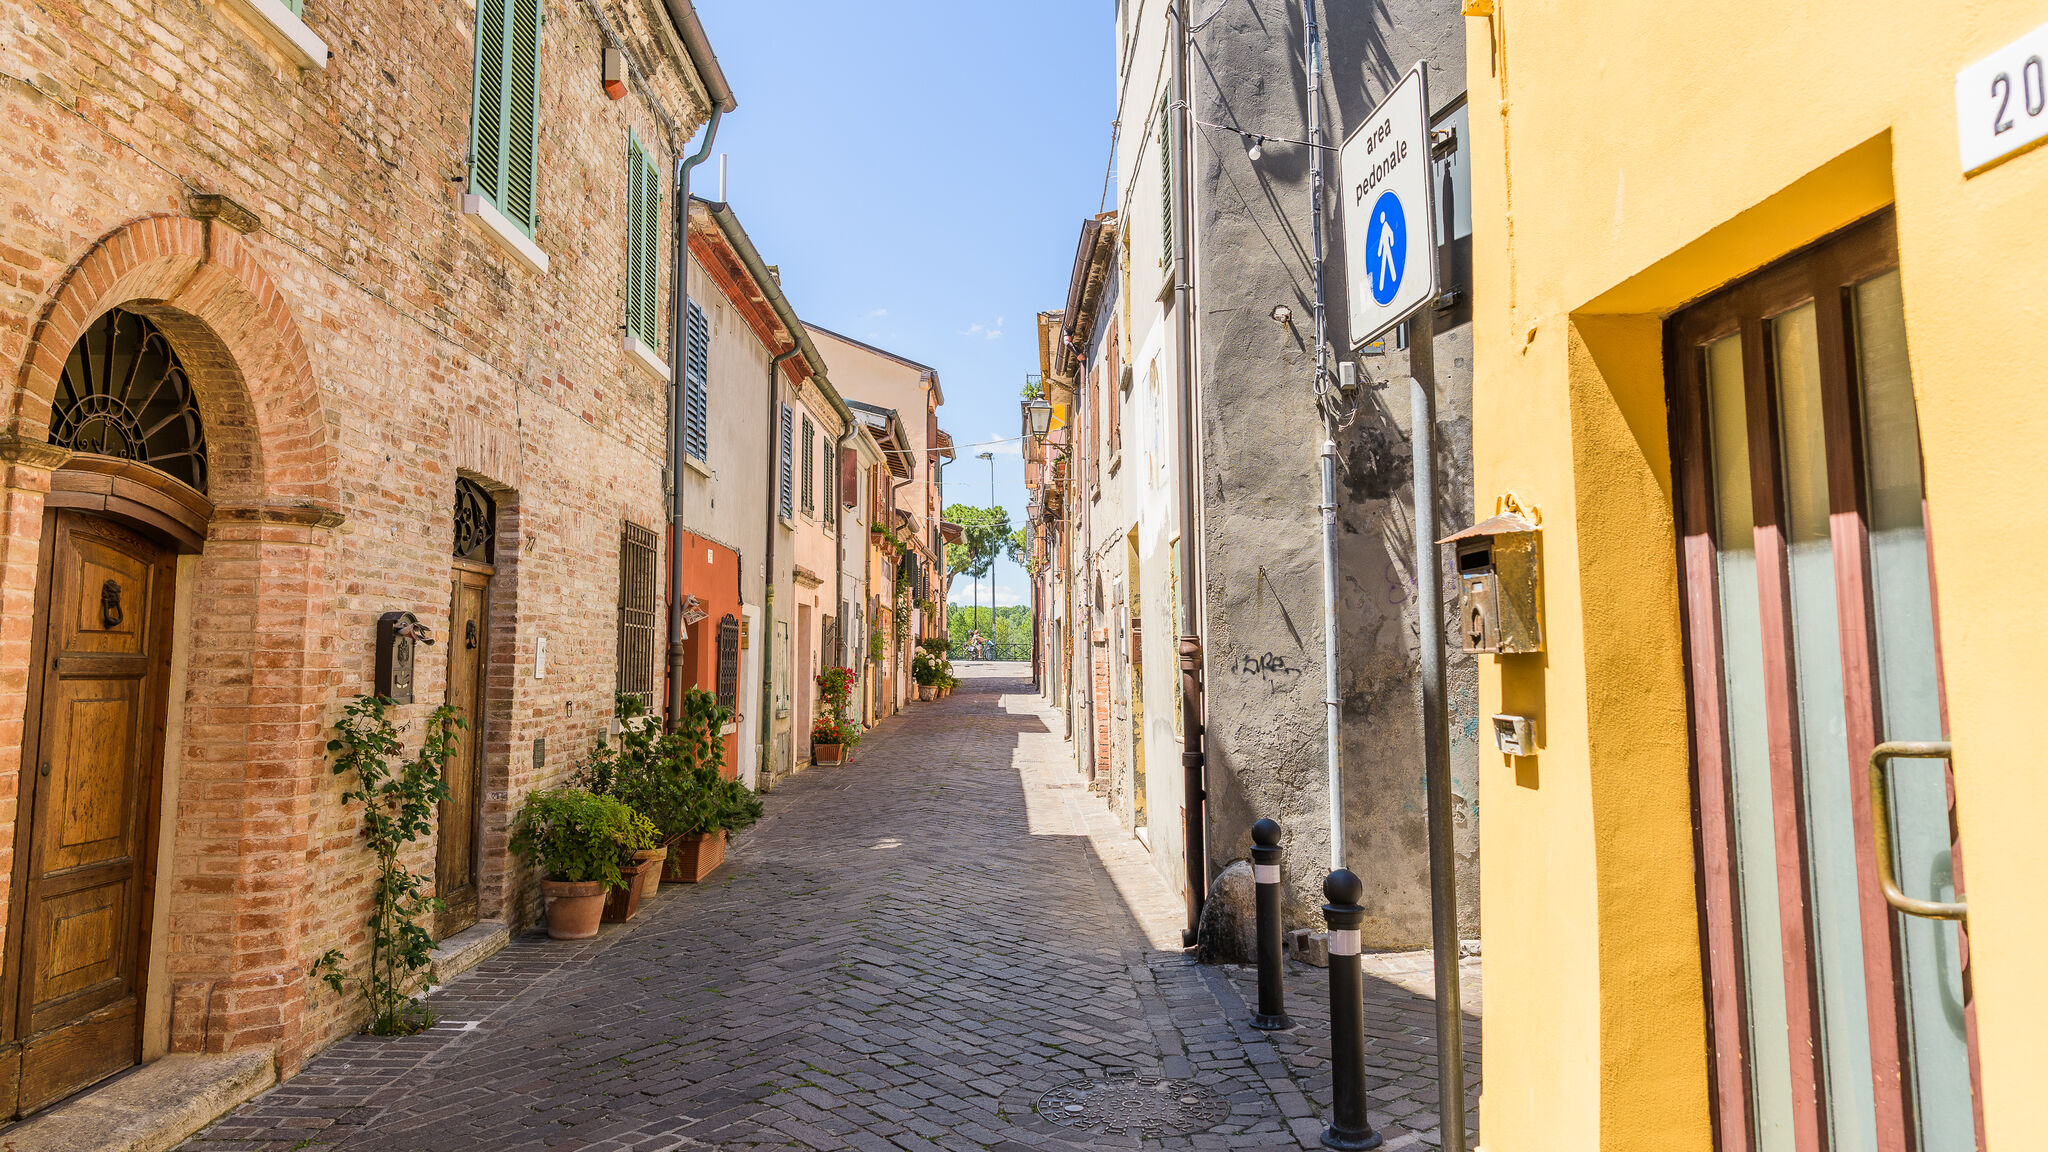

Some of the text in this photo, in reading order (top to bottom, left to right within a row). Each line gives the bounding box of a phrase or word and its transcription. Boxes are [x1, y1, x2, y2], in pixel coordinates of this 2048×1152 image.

[1991, 55, 2045, 136] 20
[1366, 117, 1391, 155] area
[1356, 140, 1408, 207] pedonale
